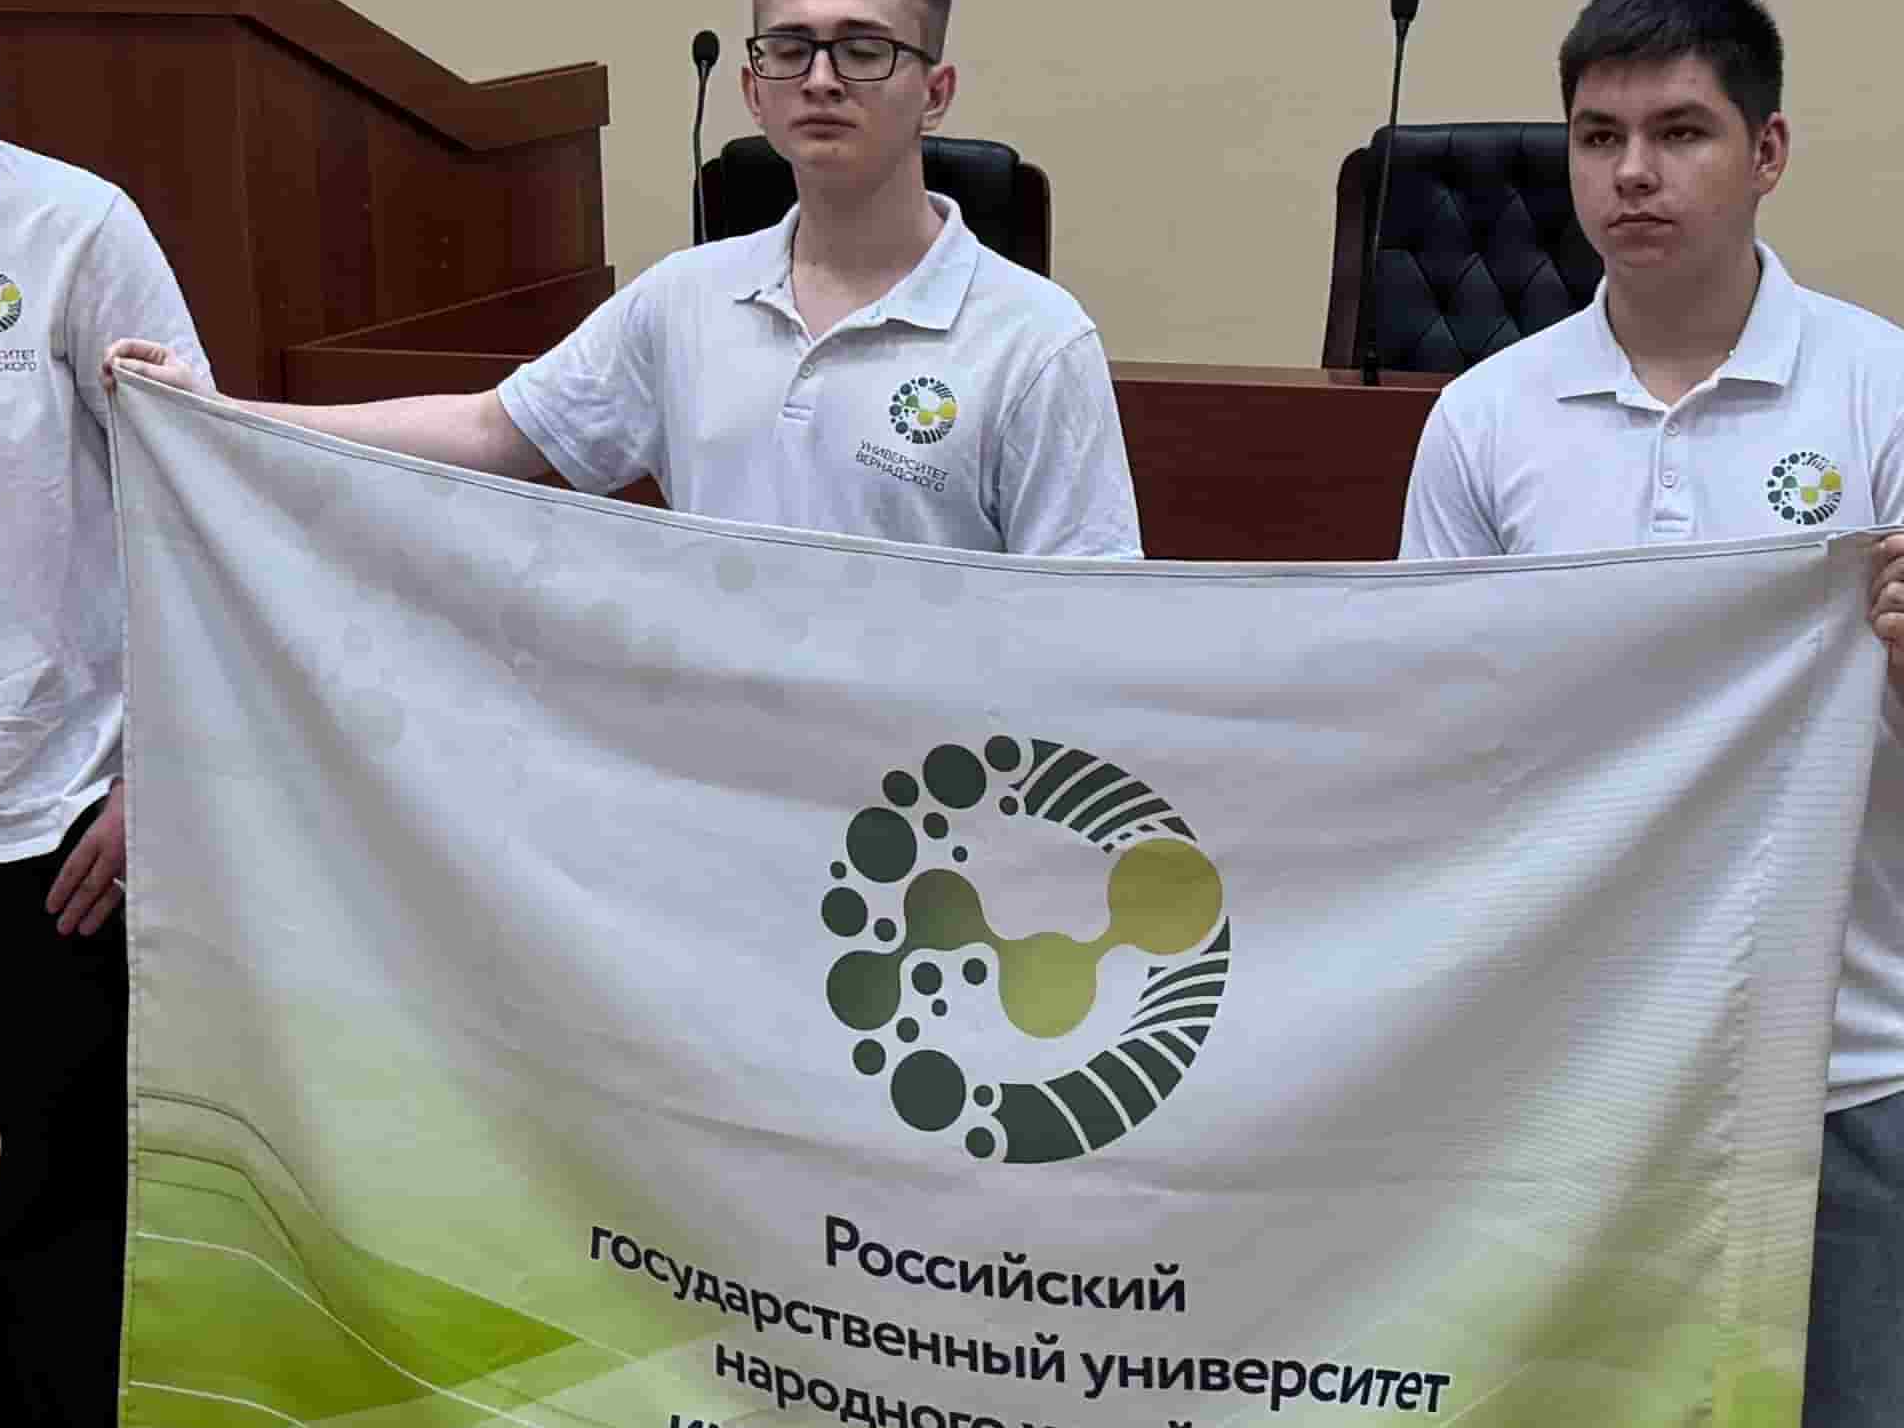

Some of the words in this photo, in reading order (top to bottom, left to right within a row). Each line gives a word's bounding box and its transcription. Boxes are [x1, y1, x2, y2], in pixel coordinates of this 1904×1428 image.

[590, 1225, 1067, 1383] государственный
[1080, 1351, 1451, 1413] университет
[824, 1215, 1186, 1312] Российский
